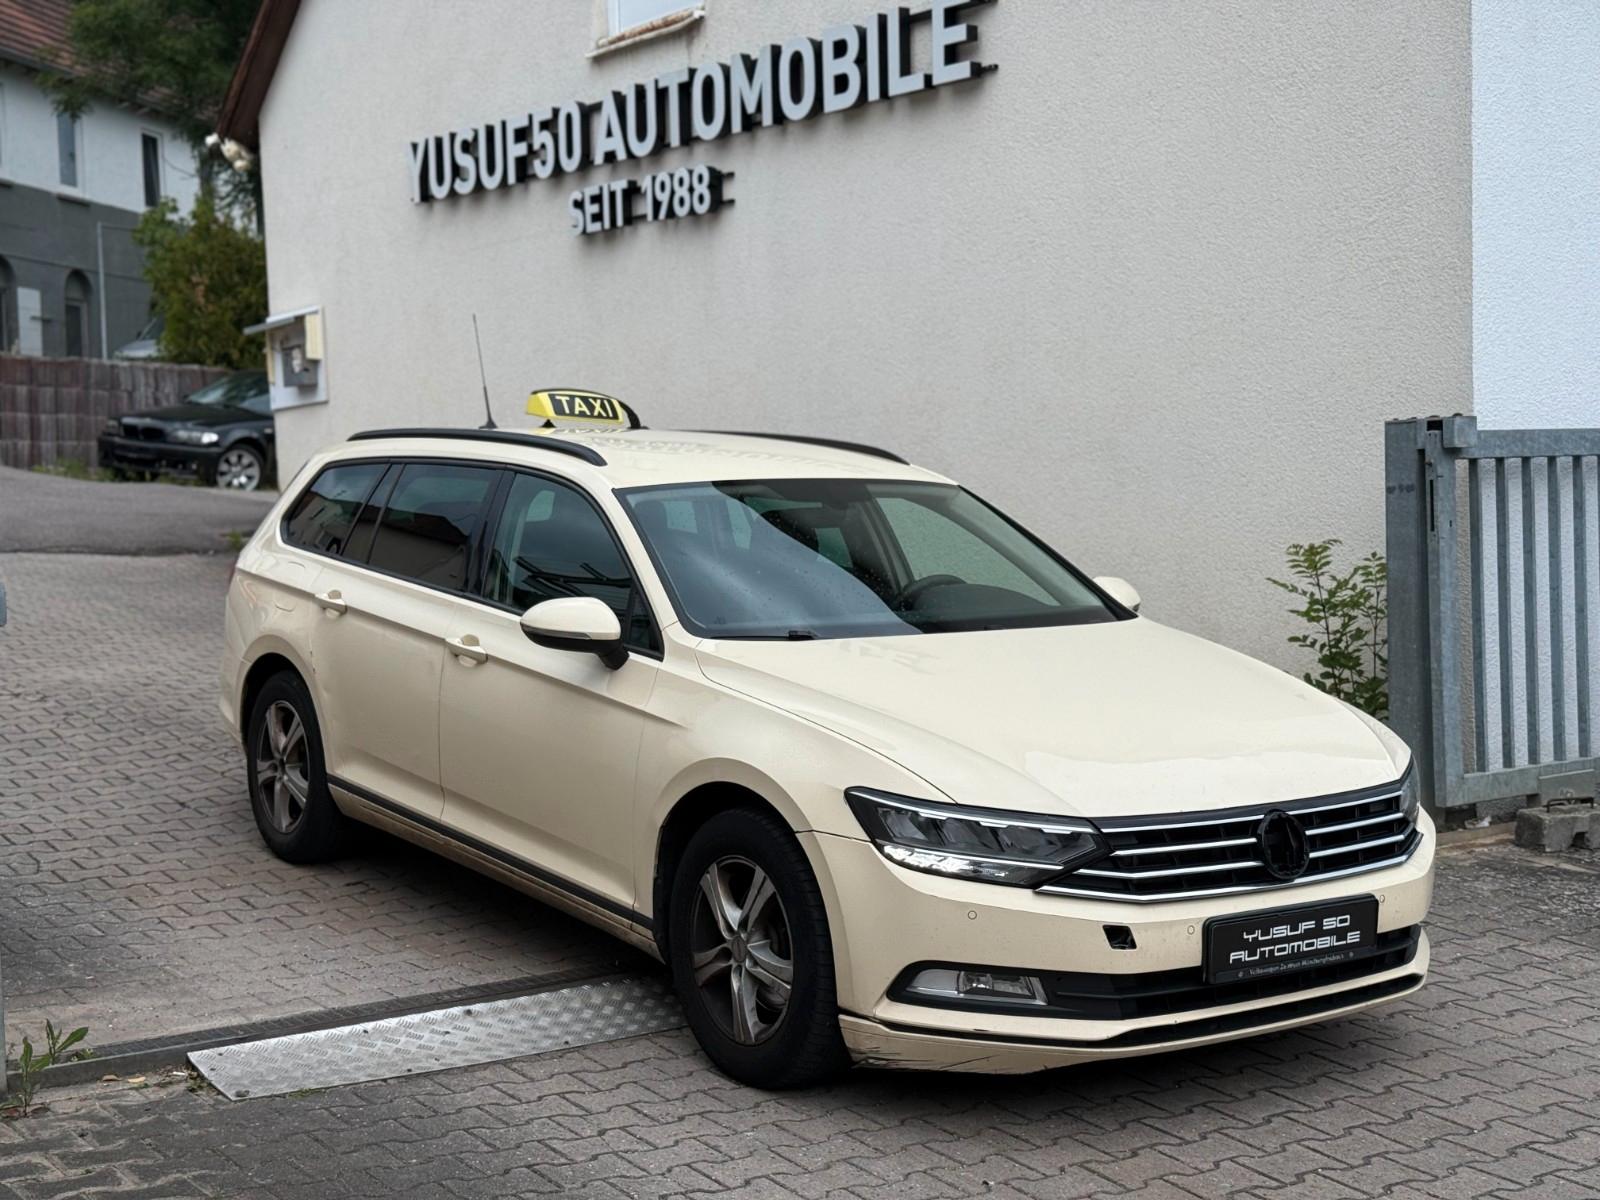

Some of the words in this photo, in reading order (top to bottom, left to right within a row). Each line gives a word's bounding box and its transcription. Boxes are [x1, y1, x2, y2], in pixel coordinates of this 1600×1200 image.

[408, 101, 582, 204] YUSUF50
[594, 0, 974, 166] AUTOMOBILE
[569, 180, 629, 236] SEIT
[641, 163, 712, 222] 1988
[555, 395, 613, 417] TAXI
[1229, 931, 1361, 964] AUTOMOBILE
[1243, 921, 1316, 942] YUSUF
